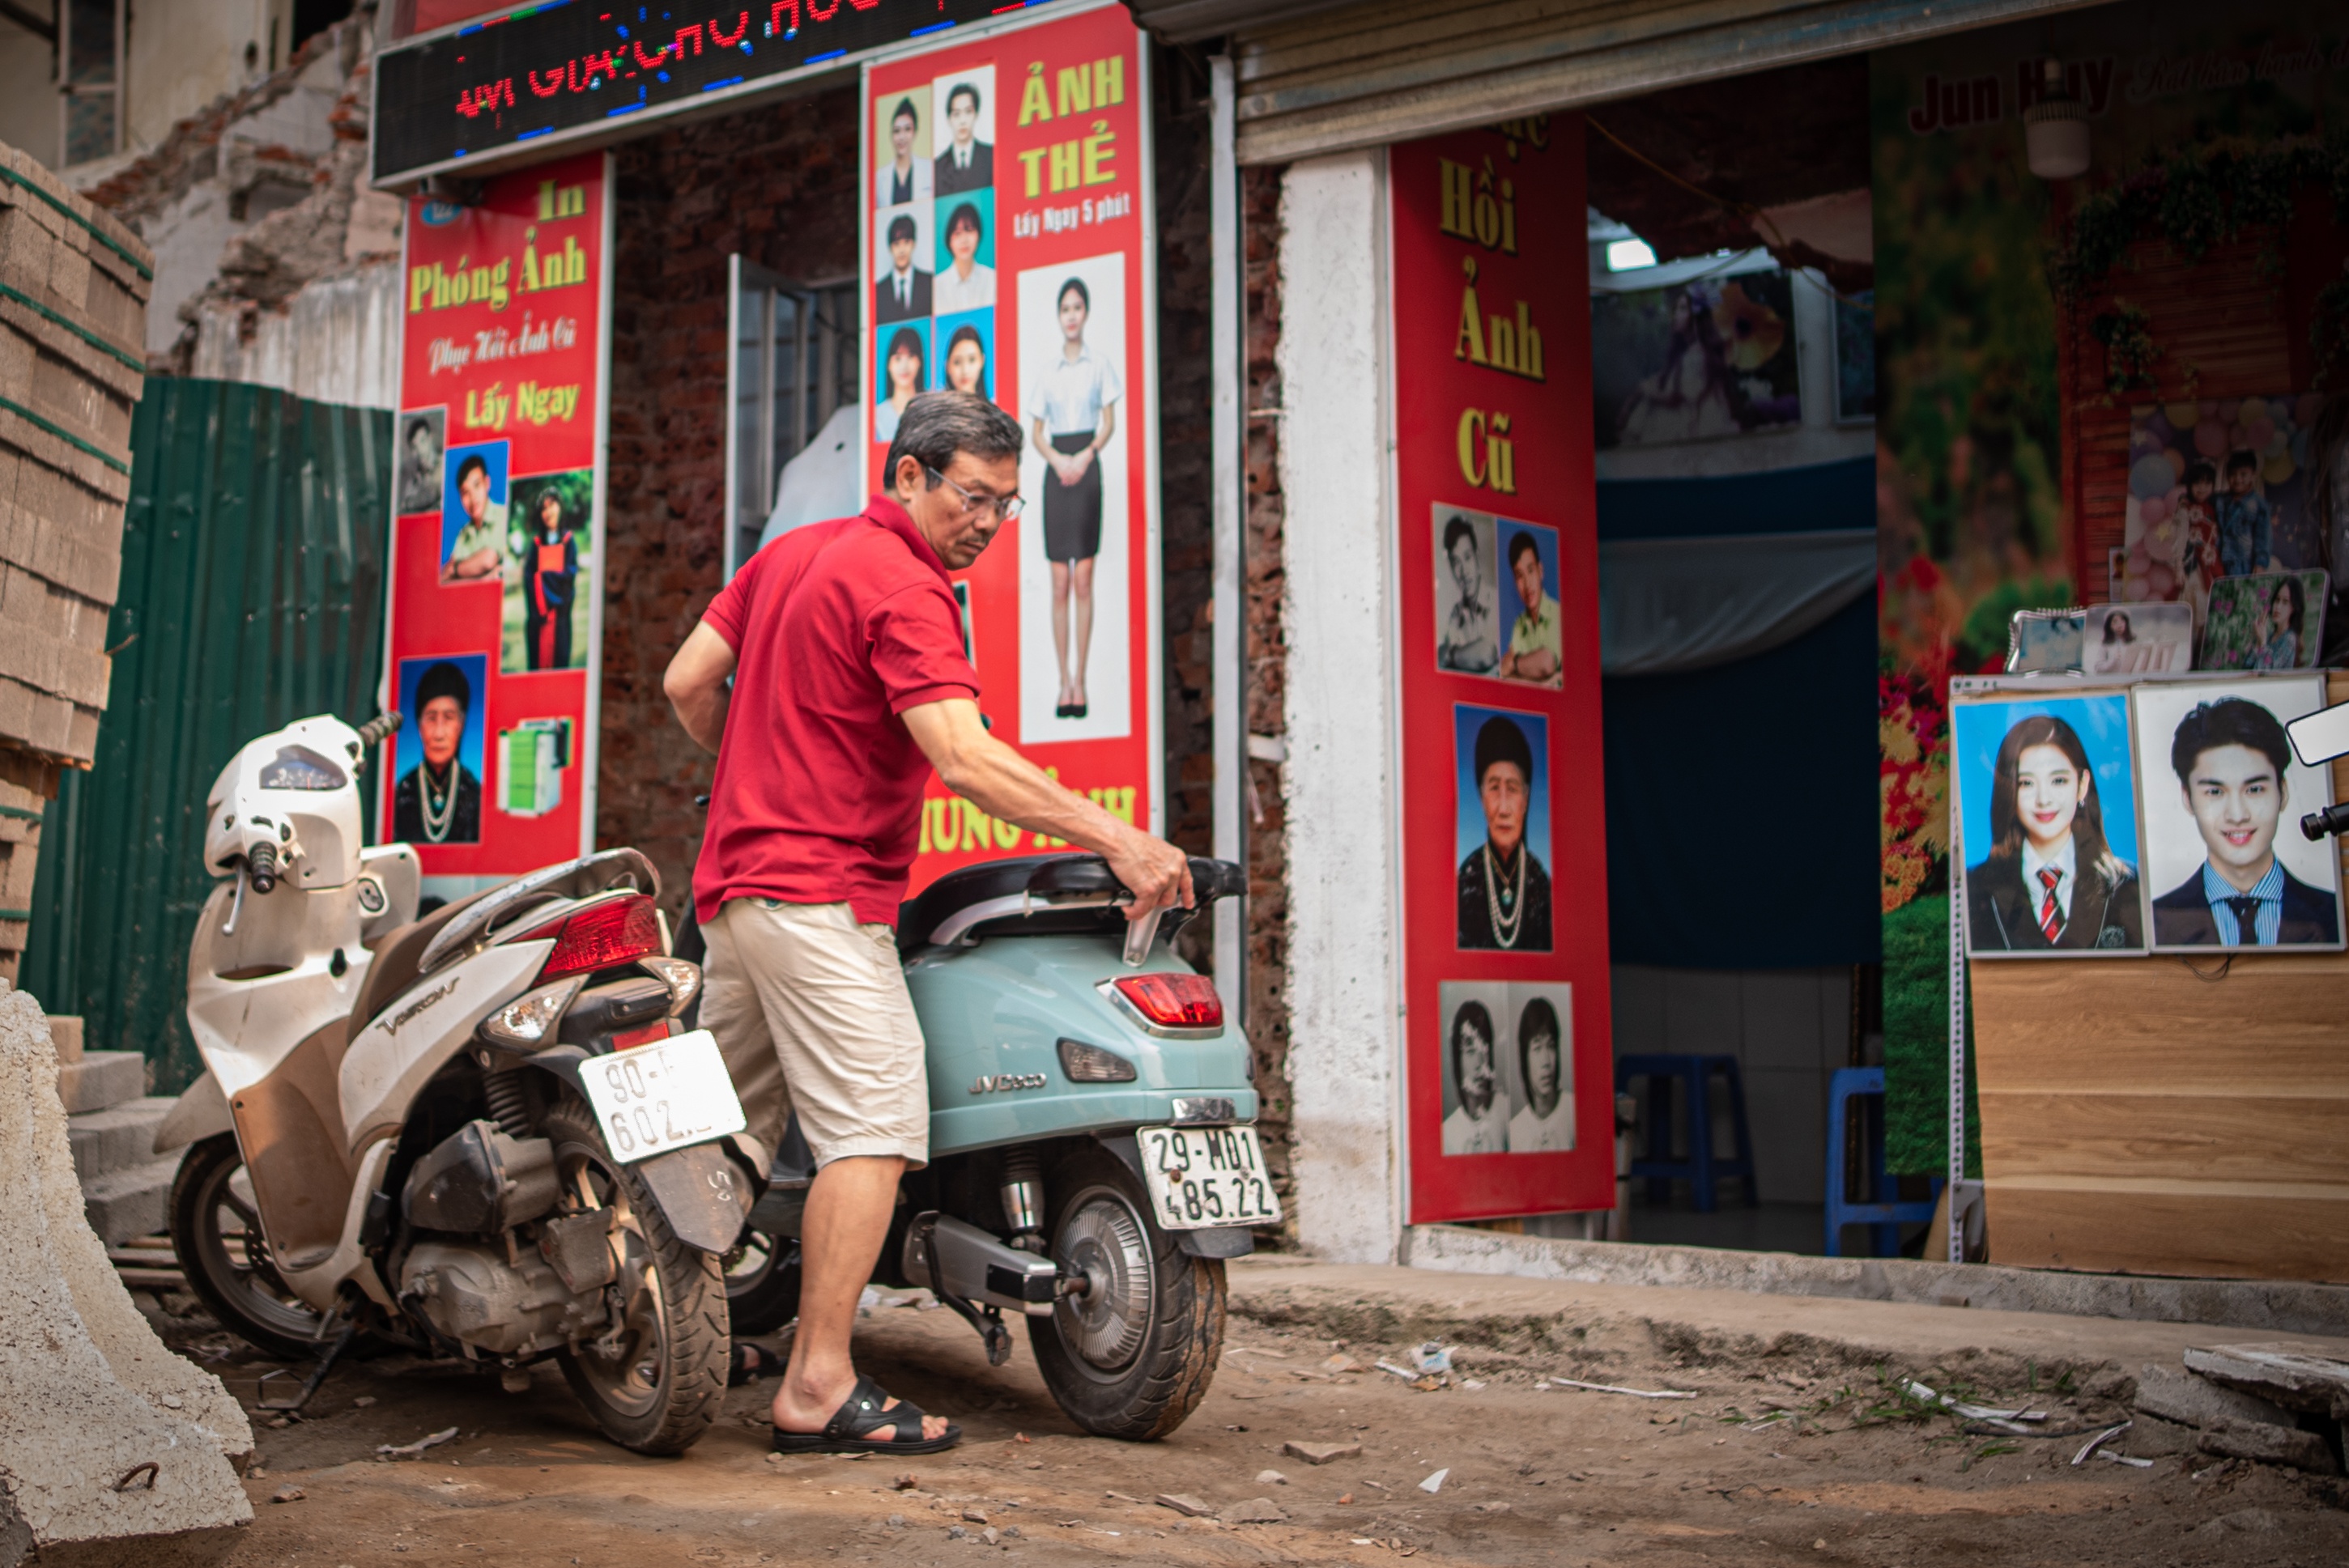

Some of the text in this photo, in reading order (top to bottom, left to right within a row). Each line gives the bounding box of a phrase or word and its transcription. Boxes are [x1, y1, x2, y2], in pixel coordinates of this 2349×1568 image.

[1017, 55, 1125, 127] ẢNH
[1909, 74, 2000, 134] Jun
[1019, 119, 1117, 199] THẺ
[538, 180, 586, 223] In
[1439, 155, 1518, 257] Hồi
[410, 226, 586, 313] Phóng Ảnh
[1455, 255, 1546, 384] Ảnh
[466, 380, 581, 431] Lấy Ngay
[1457, 407, 1518, 496] Cũ
